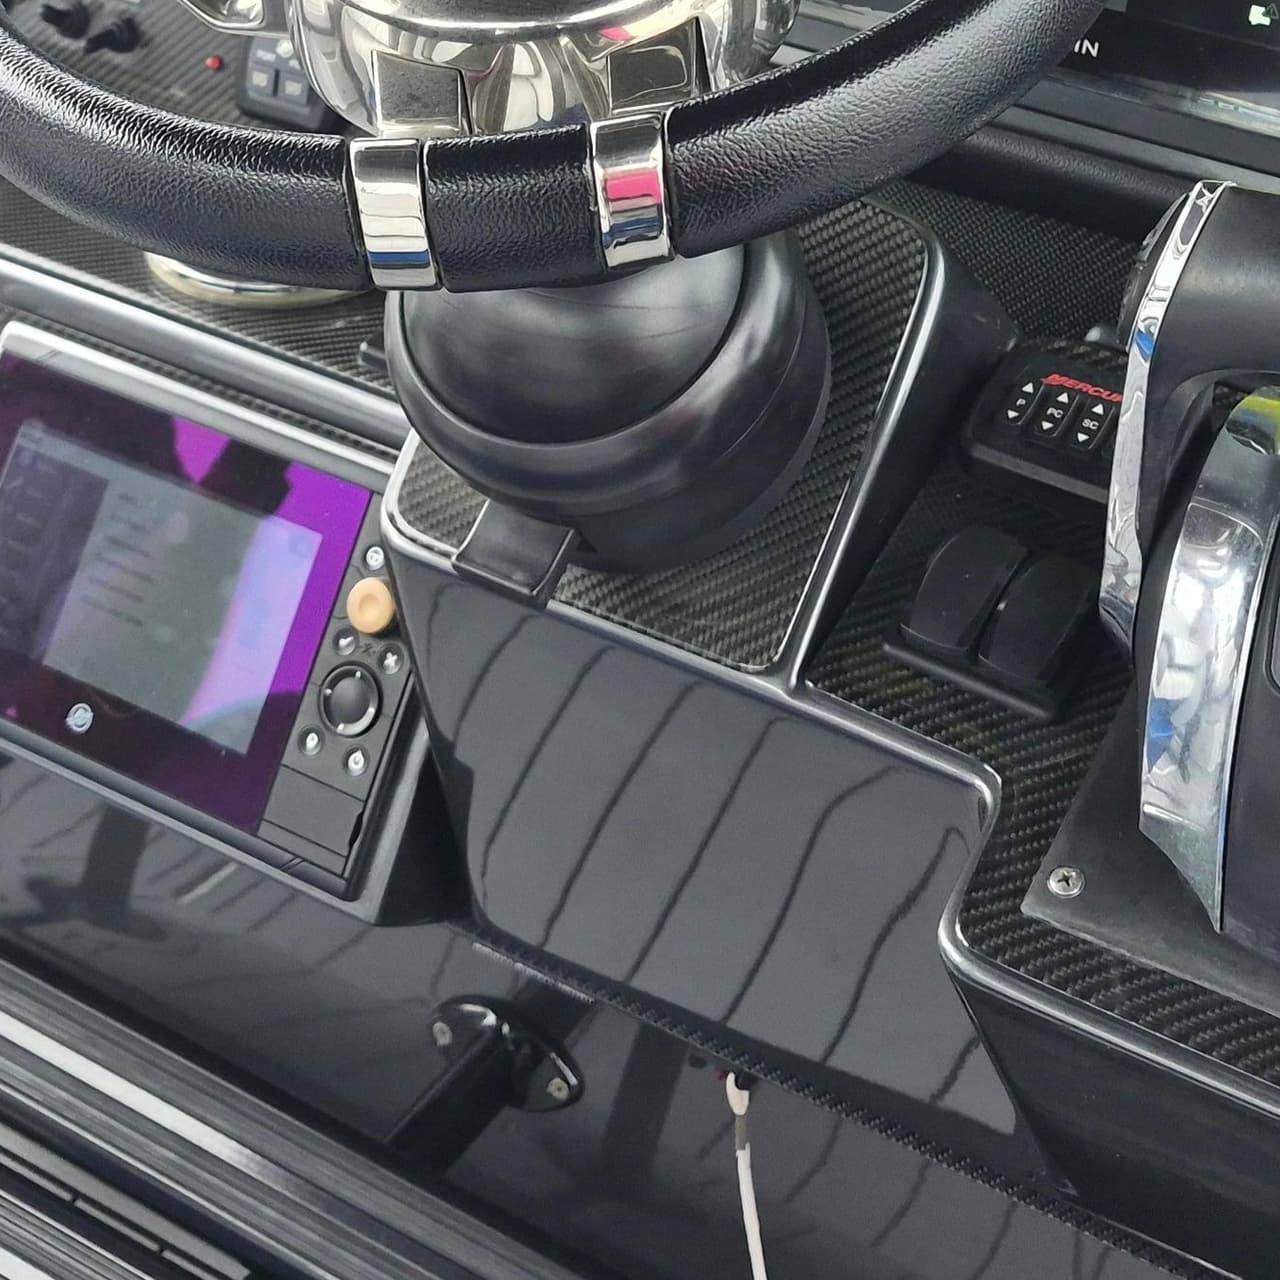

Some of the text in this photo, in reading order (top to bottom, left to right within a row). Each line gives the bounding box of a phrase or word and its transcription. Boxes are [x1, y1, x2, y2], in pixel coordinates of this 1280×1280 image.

[1016, 398, 1026, 407] P
[1046, 407, 1064, 418] PC
[1082, 419, 1099, 430] SC
